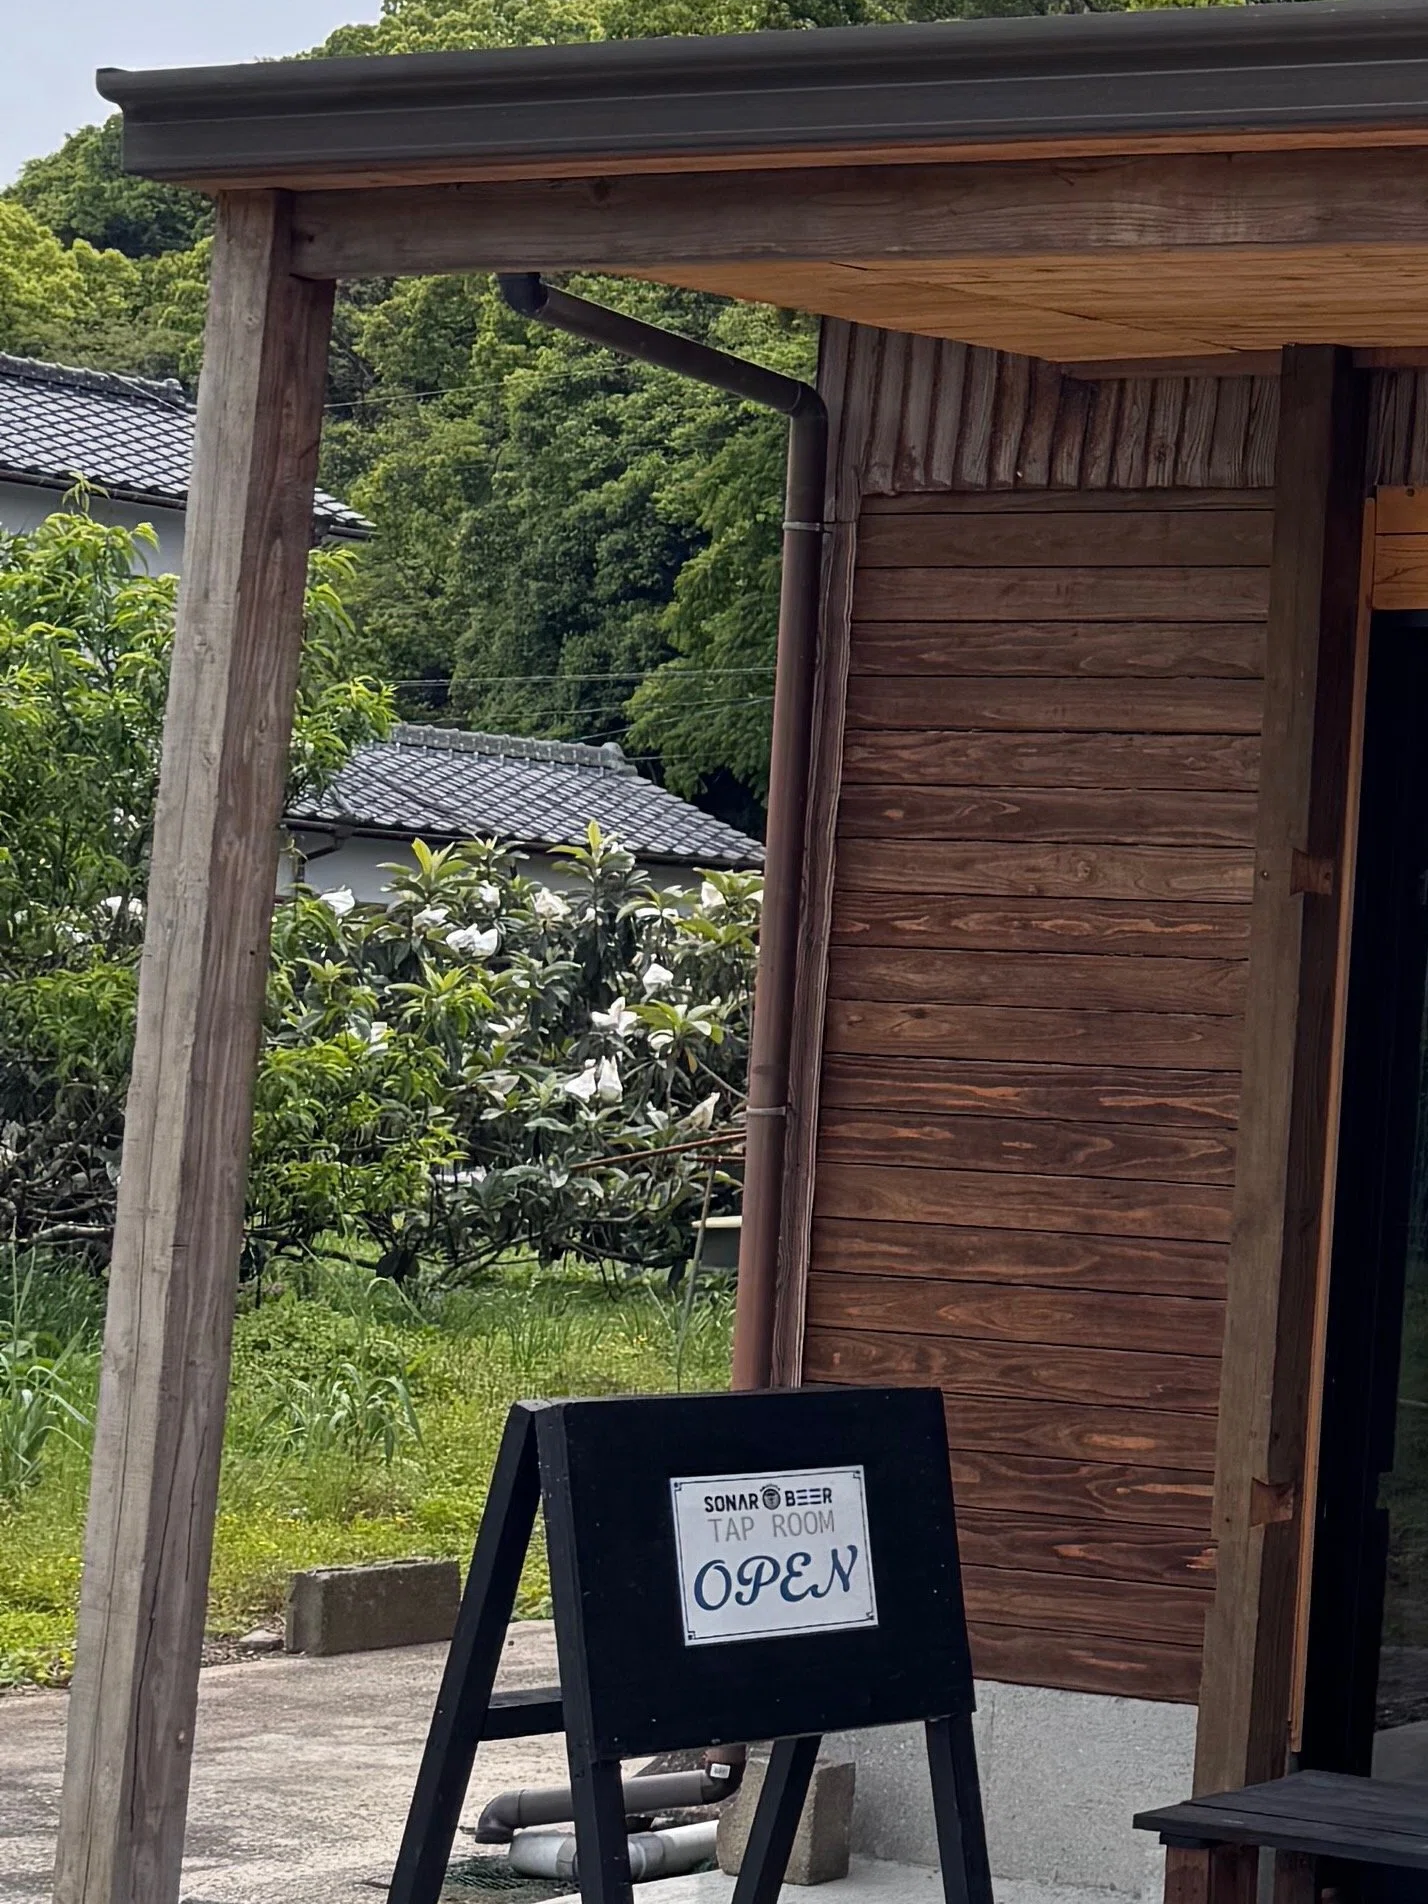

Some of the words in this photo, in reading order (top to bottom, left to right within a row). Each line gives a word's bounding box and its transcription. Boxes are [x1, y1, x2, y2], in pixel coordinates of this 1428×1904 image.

[704, 1492, 759, 1513] SONAR
[785, 1487, 833, 1507] BEER
[707, 1516, 756, 1543] TAP
[772, 1509, 836, 1538] ROOM
[693, 1544, 859, 1612] OPEN
